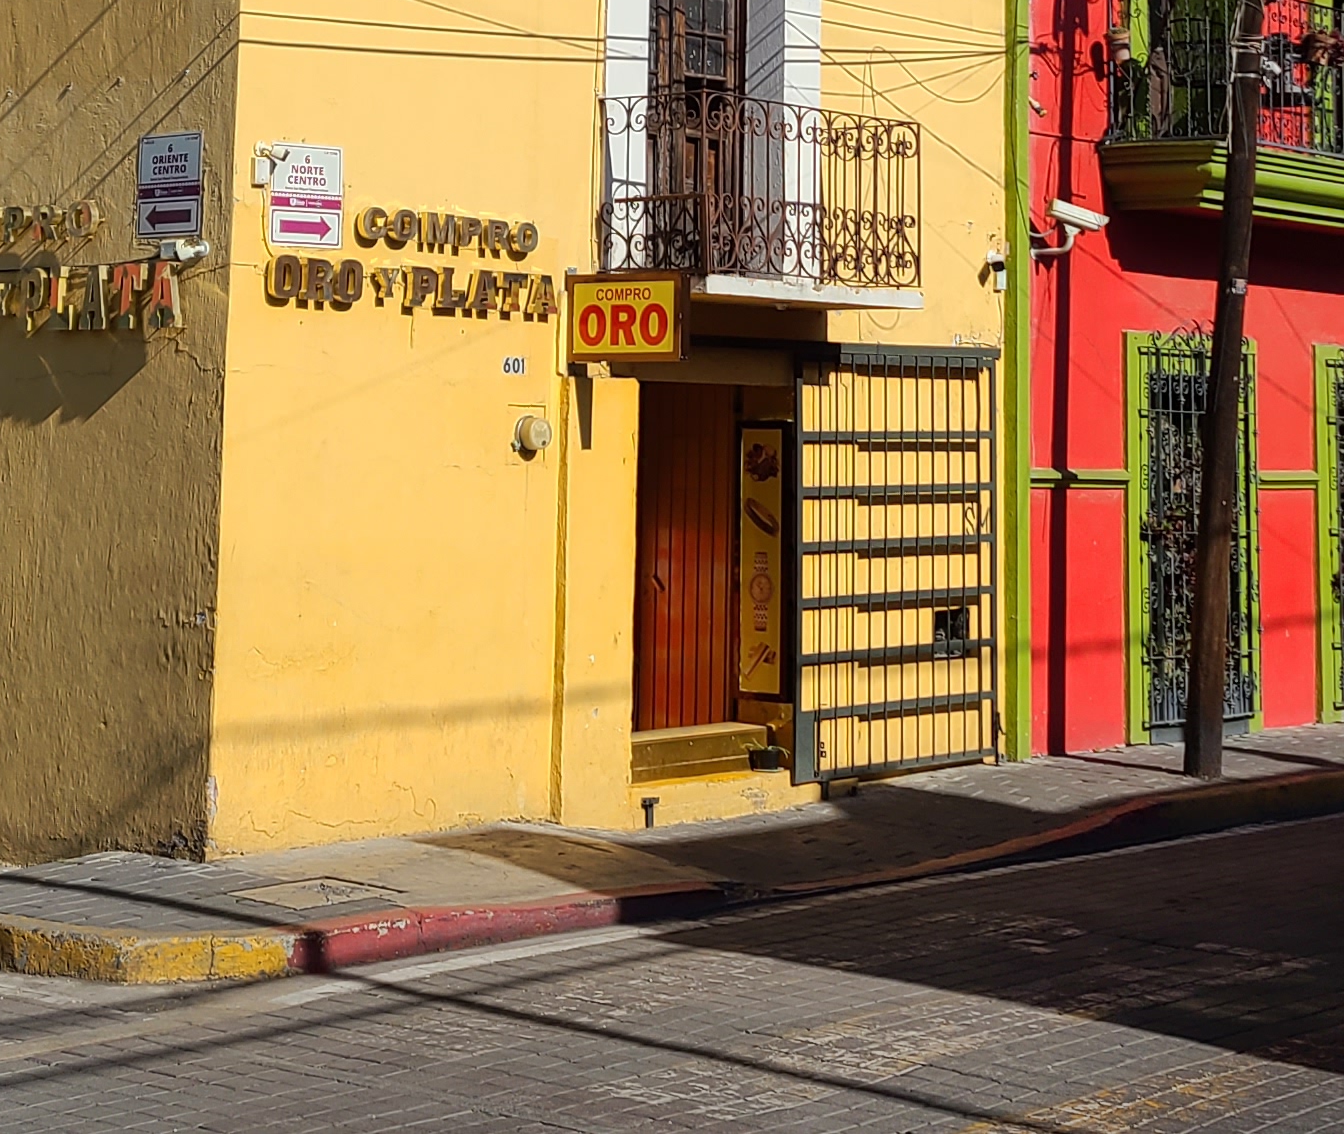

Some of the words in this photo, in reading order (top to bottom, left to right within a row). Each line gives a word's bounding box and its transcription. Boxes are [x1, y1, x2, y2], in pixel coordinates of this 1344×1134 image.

[167, 144, 173, 153] 6
[152, 153, 189, 165] ORIENTE
[304, 155, 311, 164] 6
[152, 164, 187, 176] CENTRO
[291, 165, 324, 176] NORTE
[287, 175, 327, 187] CENTRO
[358, 207, 539, 253] COMPRO
[267, 254, 363, 303] ORO
[403, 265, 558, 315] PLATA
[21, 261, 181, 331] PLATA
[595, 287, 652, 302] COMPRO
[578, 303, 668, 347] ORO
[503, 358, 525, 375] 601
